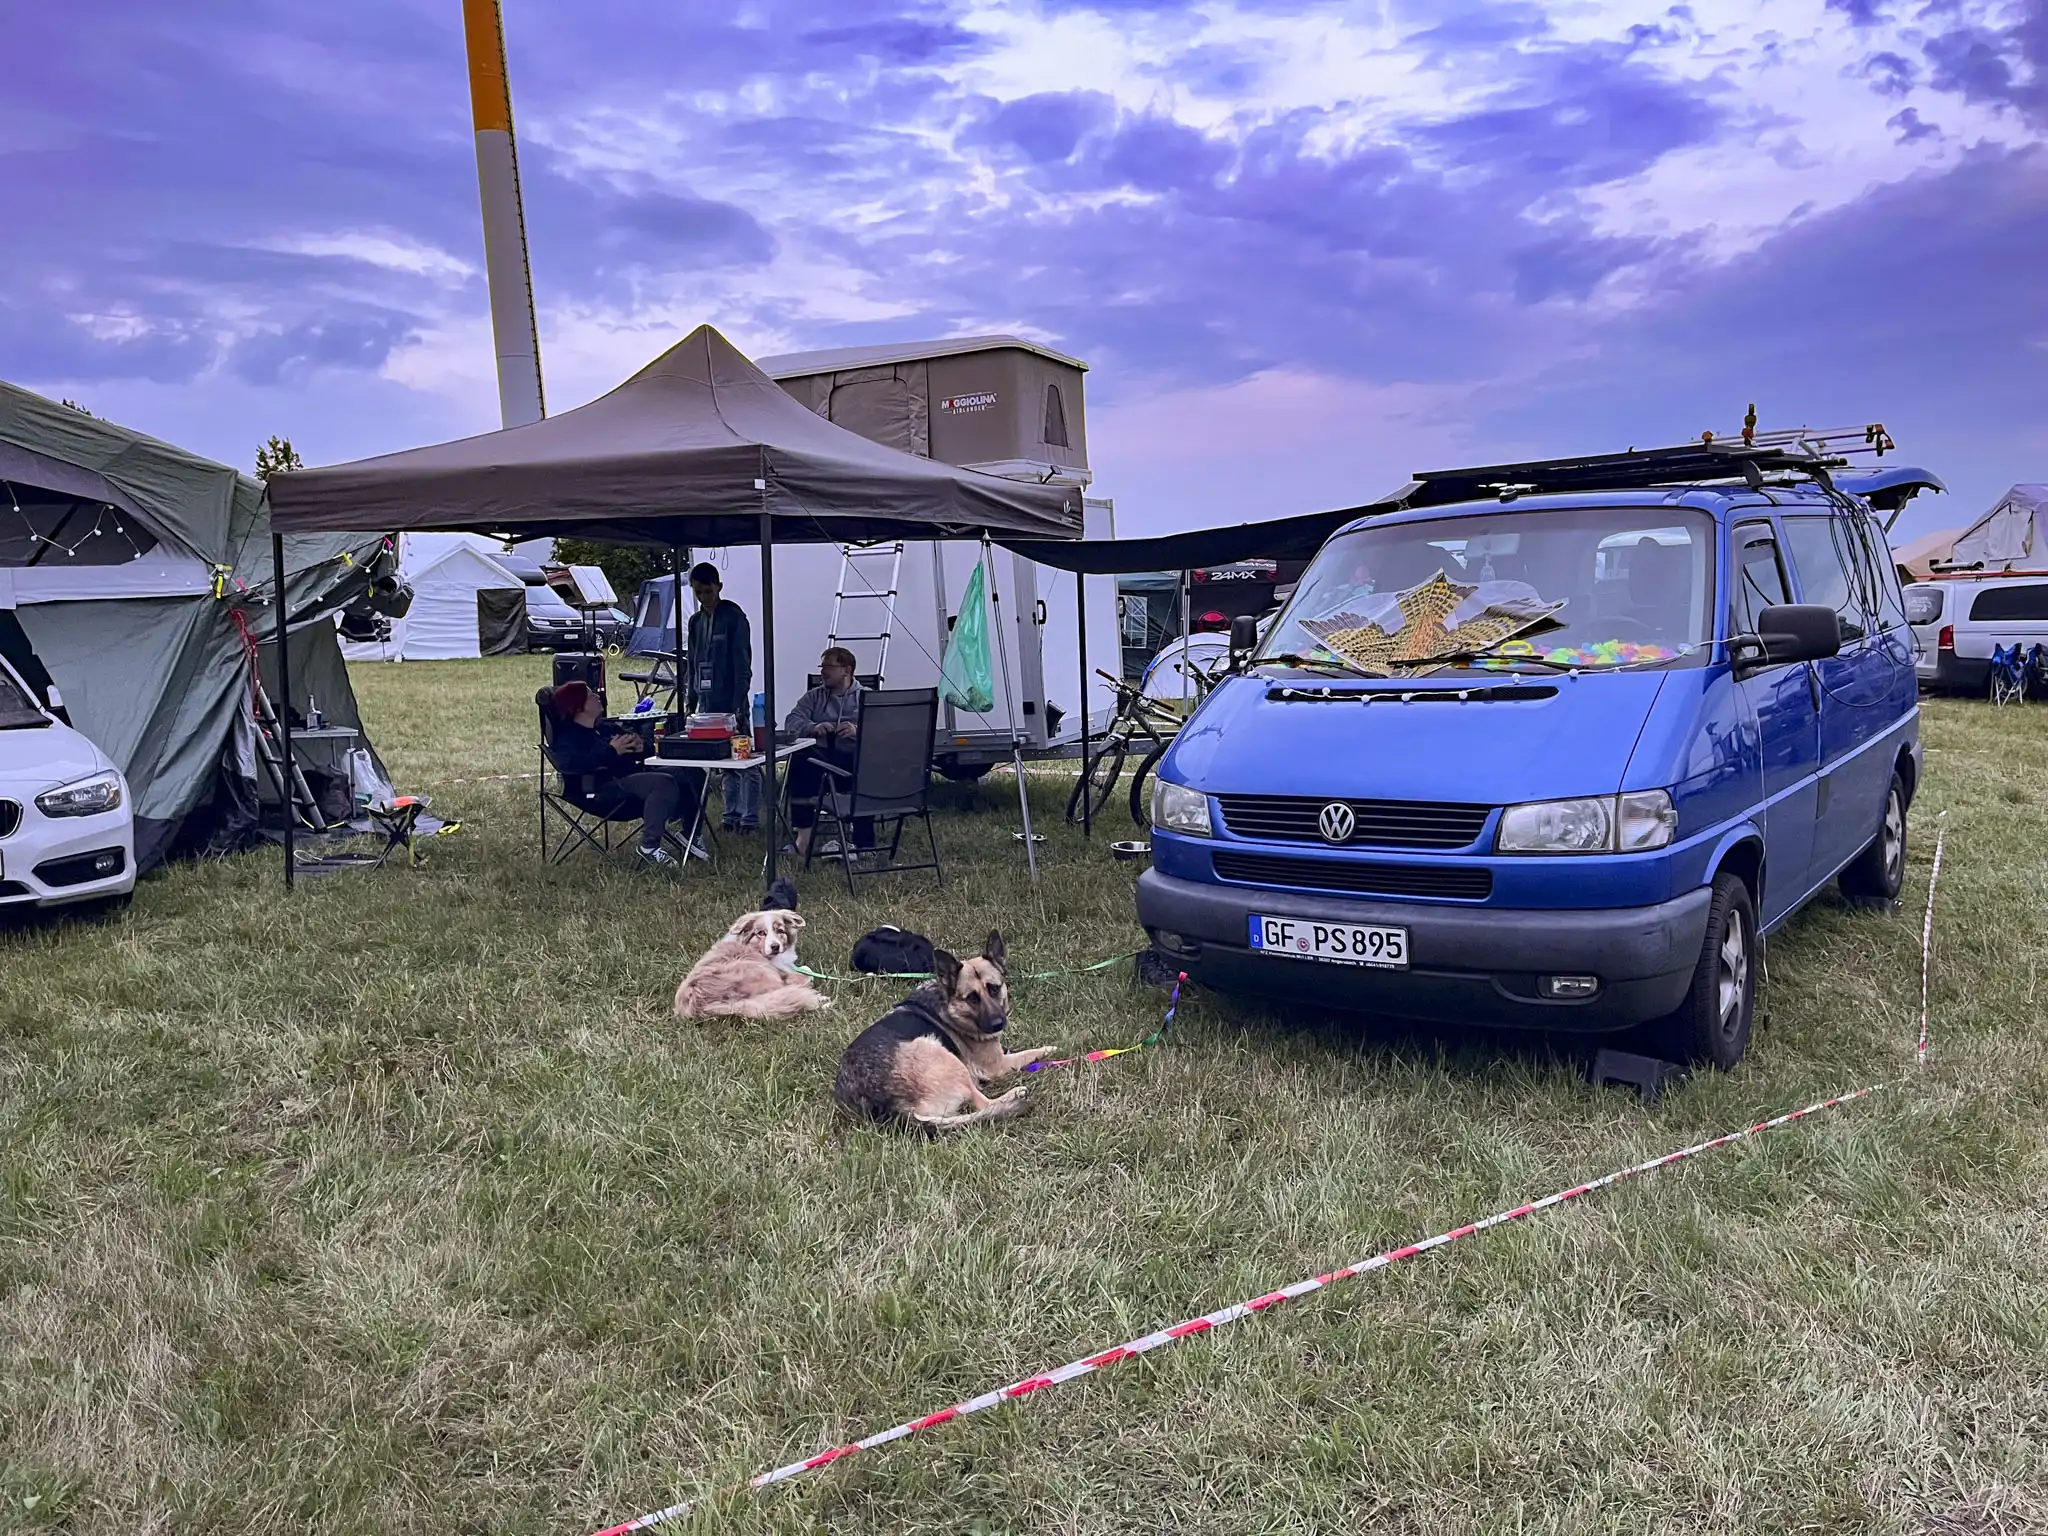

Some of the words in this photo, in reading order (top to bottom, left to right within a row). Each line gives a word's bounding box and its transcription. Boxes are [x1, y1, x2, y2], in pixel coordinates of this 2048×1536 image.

[1211, 571, 1256, 580] 24MX
[1265, 920, 1295, 947] GF
[1313, 925, 1346, 953] PS
[1352, 930, 1402, 959] 895
